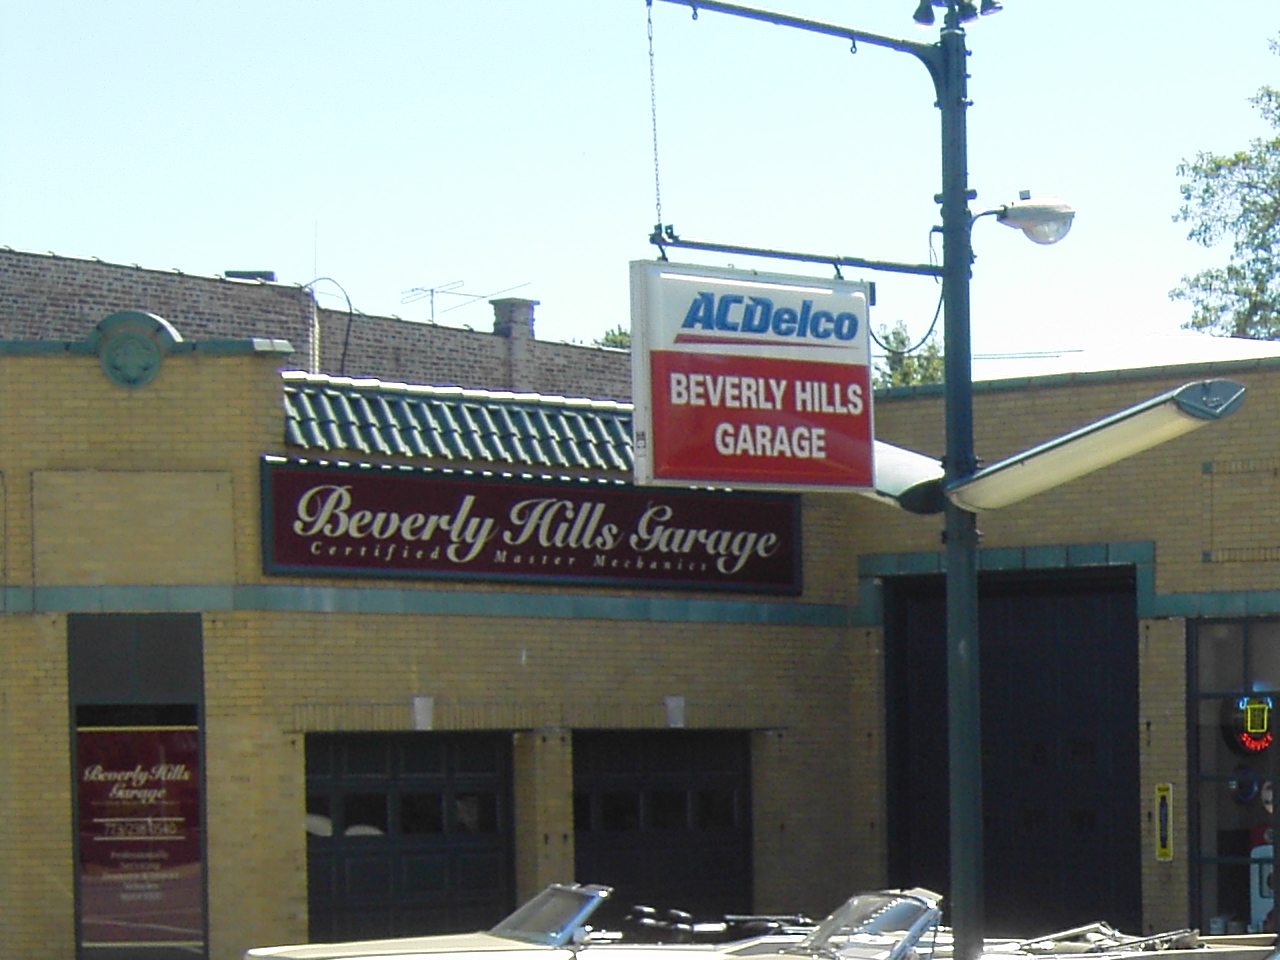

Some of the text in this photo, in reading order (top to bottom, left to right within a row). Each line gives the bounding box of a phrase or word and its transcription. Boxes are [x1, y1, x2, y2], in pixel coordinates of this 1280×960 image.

[681, 291, 859, 341] ACDelco
[670, 372, 863, 416] BEVERLY HILLS
[714, 422, 826, 459] GARAGE
[293, 484, 780, 574] Beverly Hills Garage
[310, 541, 708, 571] Certified Master Mechanics
[83, 763, 190, 787] Beverly Hills
[109, 782, 167, 804] Garage
